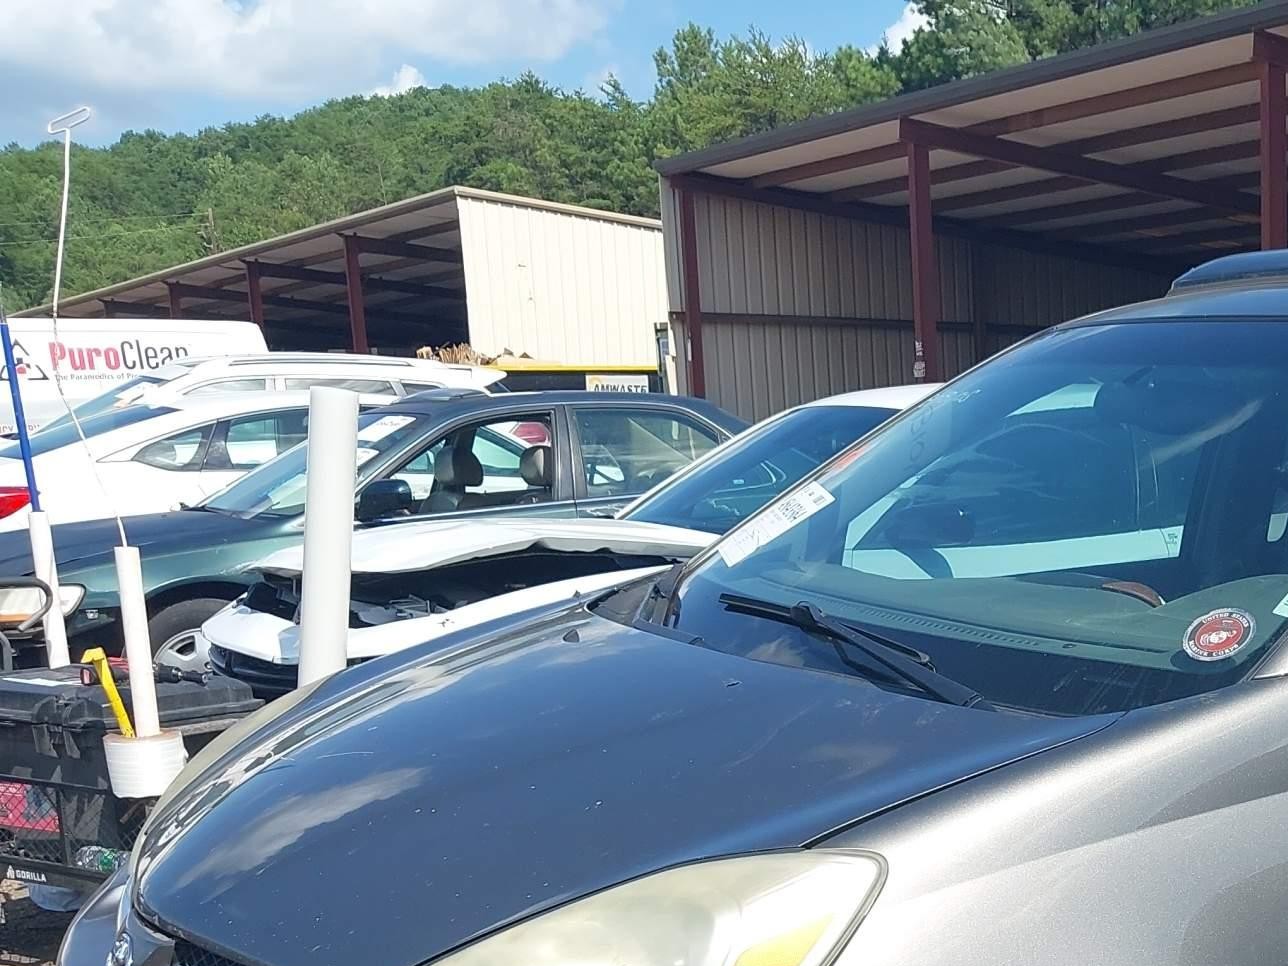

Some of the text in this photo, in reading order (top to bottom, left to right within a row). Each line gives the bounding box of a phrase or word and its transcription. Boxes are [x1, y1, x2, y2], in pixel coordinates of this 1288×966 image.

[48, 339, 189, 370] PuroClean
[70, 373, 114, 381] Paramedics
[1202, 612, 1249, 628] UNITED STATES
[1188, 640, 1239, 657] MARINE CORPS
[15, 869, 47, 882] GORILLA
